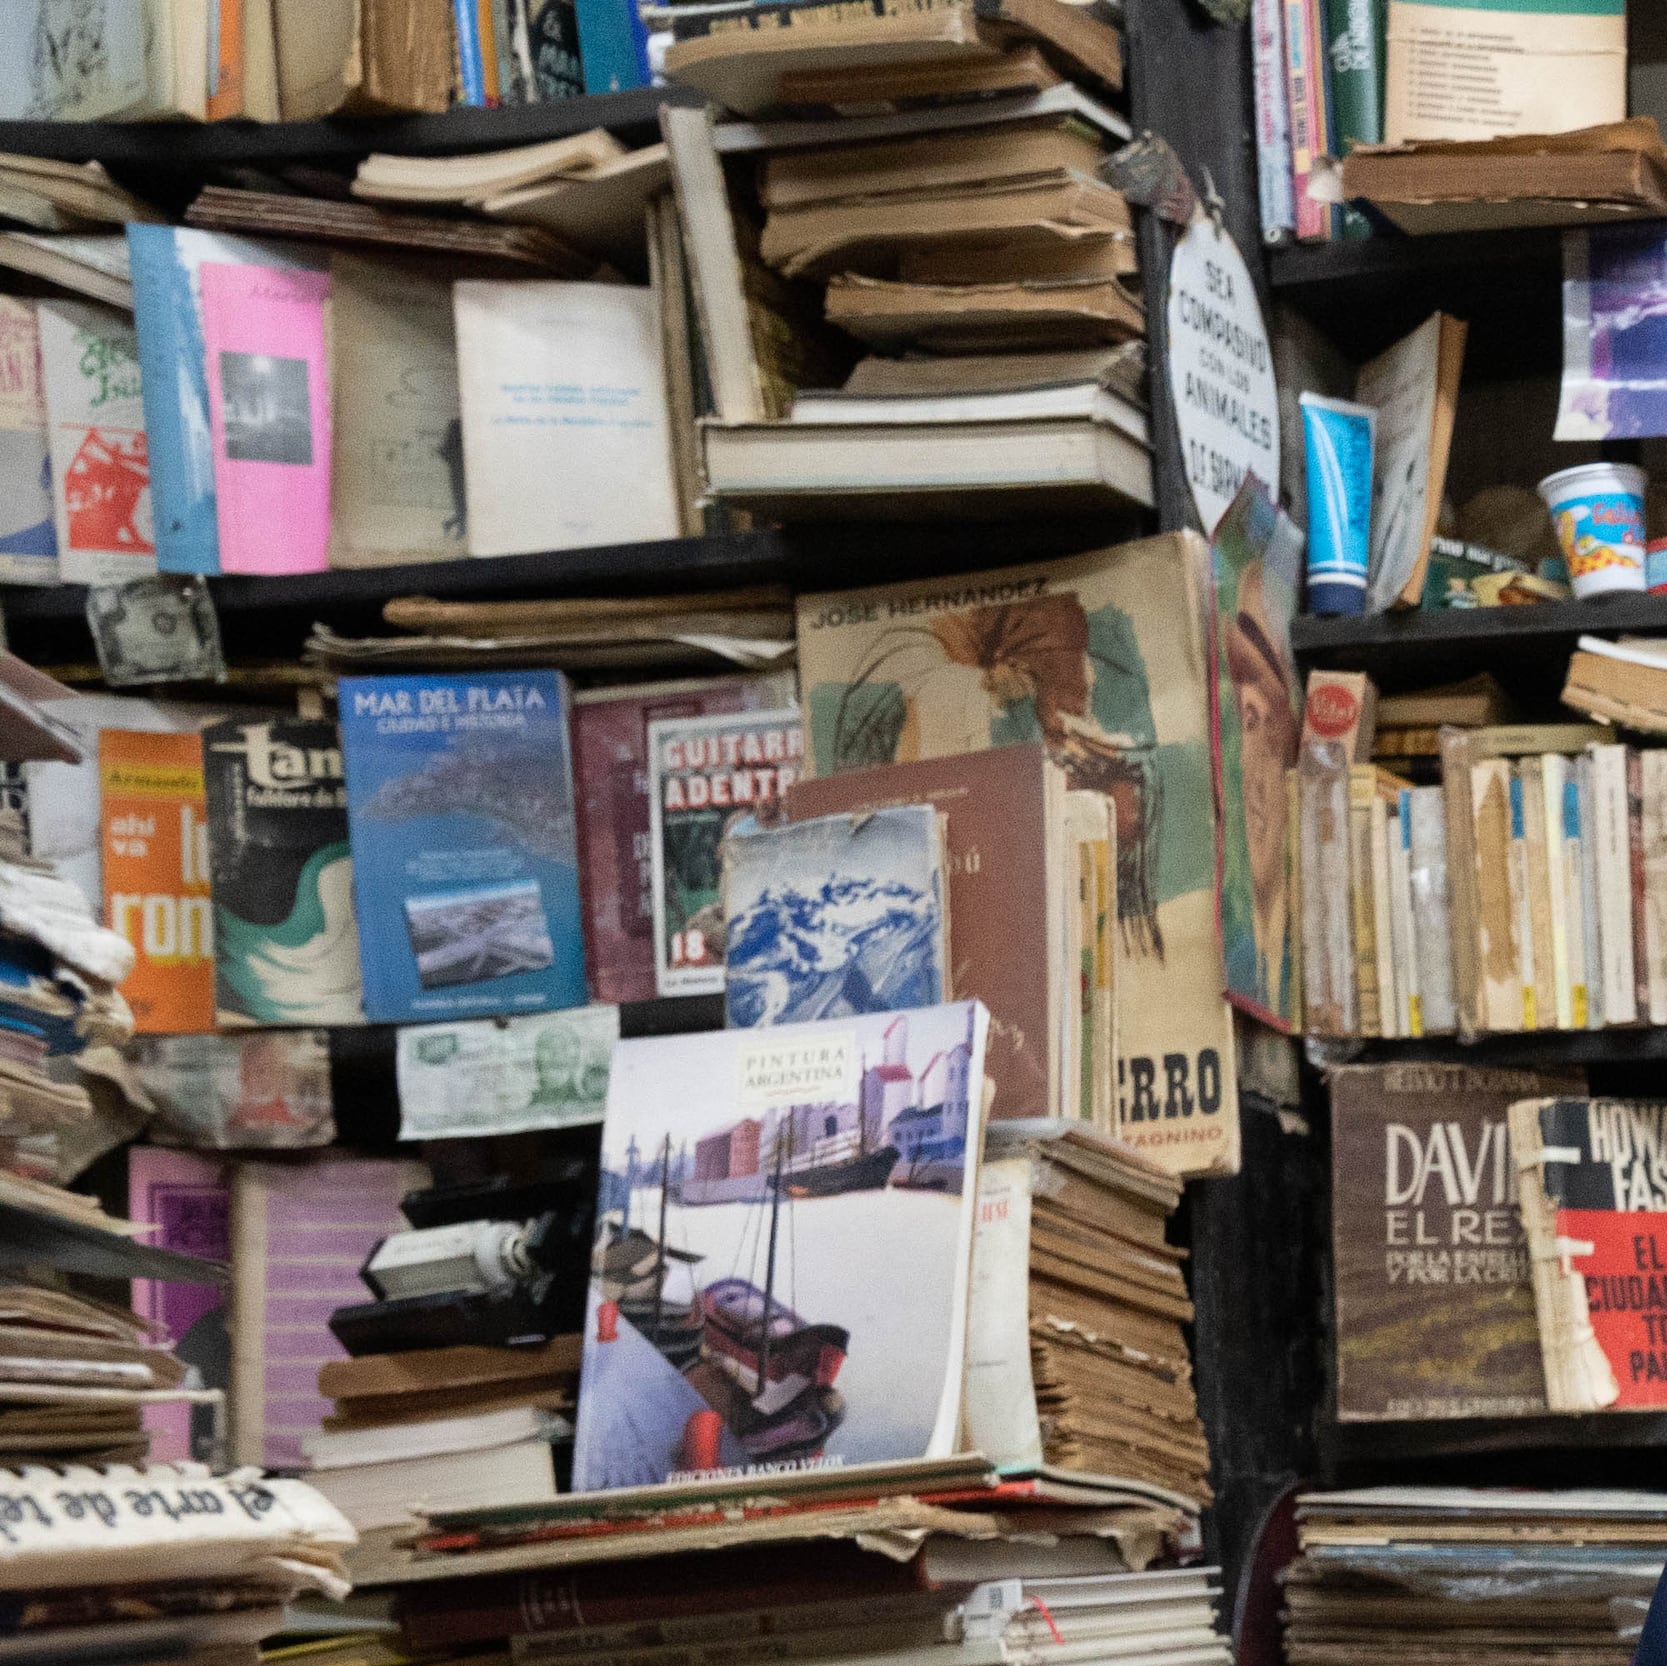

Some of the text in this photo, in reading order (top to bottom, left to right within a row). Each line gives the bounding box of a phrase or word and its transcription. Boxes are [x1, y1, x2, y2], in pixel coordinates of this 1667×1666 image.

[1184, 379, 1275, 450] ANIMALES
[811, 577, 1050, 629] JOSE HERNANDEZ
[354, 688, 411, 717] MAR
[417, 687, 463, 715] DEL
[112, 837, 149, 856] va
[746, 1045, 847, 1070] PINTURA
[744, 1066, 844, 1089] ARGENTINA
[1386, 1209, 1439, 1246] EL
[1632, 1235, 1664, 1271] EL
[744, 1461, 794, 1479] BANCO
